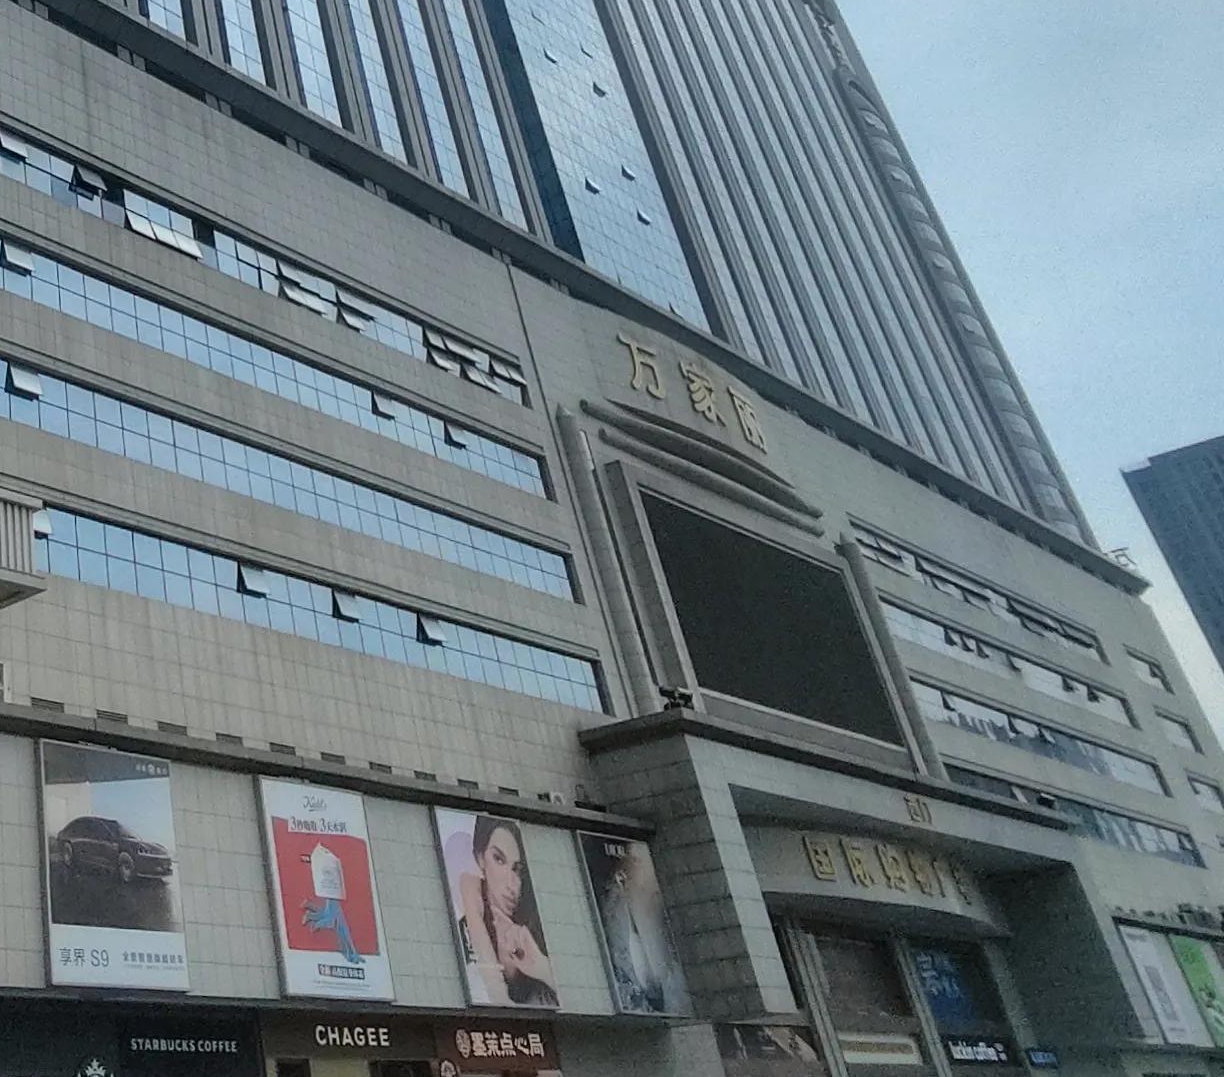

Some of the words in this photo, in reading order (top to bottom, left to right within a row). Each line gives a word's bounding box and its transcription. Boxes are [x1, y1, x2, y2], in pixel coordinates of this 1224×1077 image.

[617, 332, 767, 454] 万家丽
[59, 948, 86, 968] 享界
[89, 949, 110, 968] S9
[130, 1038, 195, 1051] STARBUCKS
[197, 1039, 238, 1053] COFFEE
[315, 1025, 390, 1047] CHAGEE
